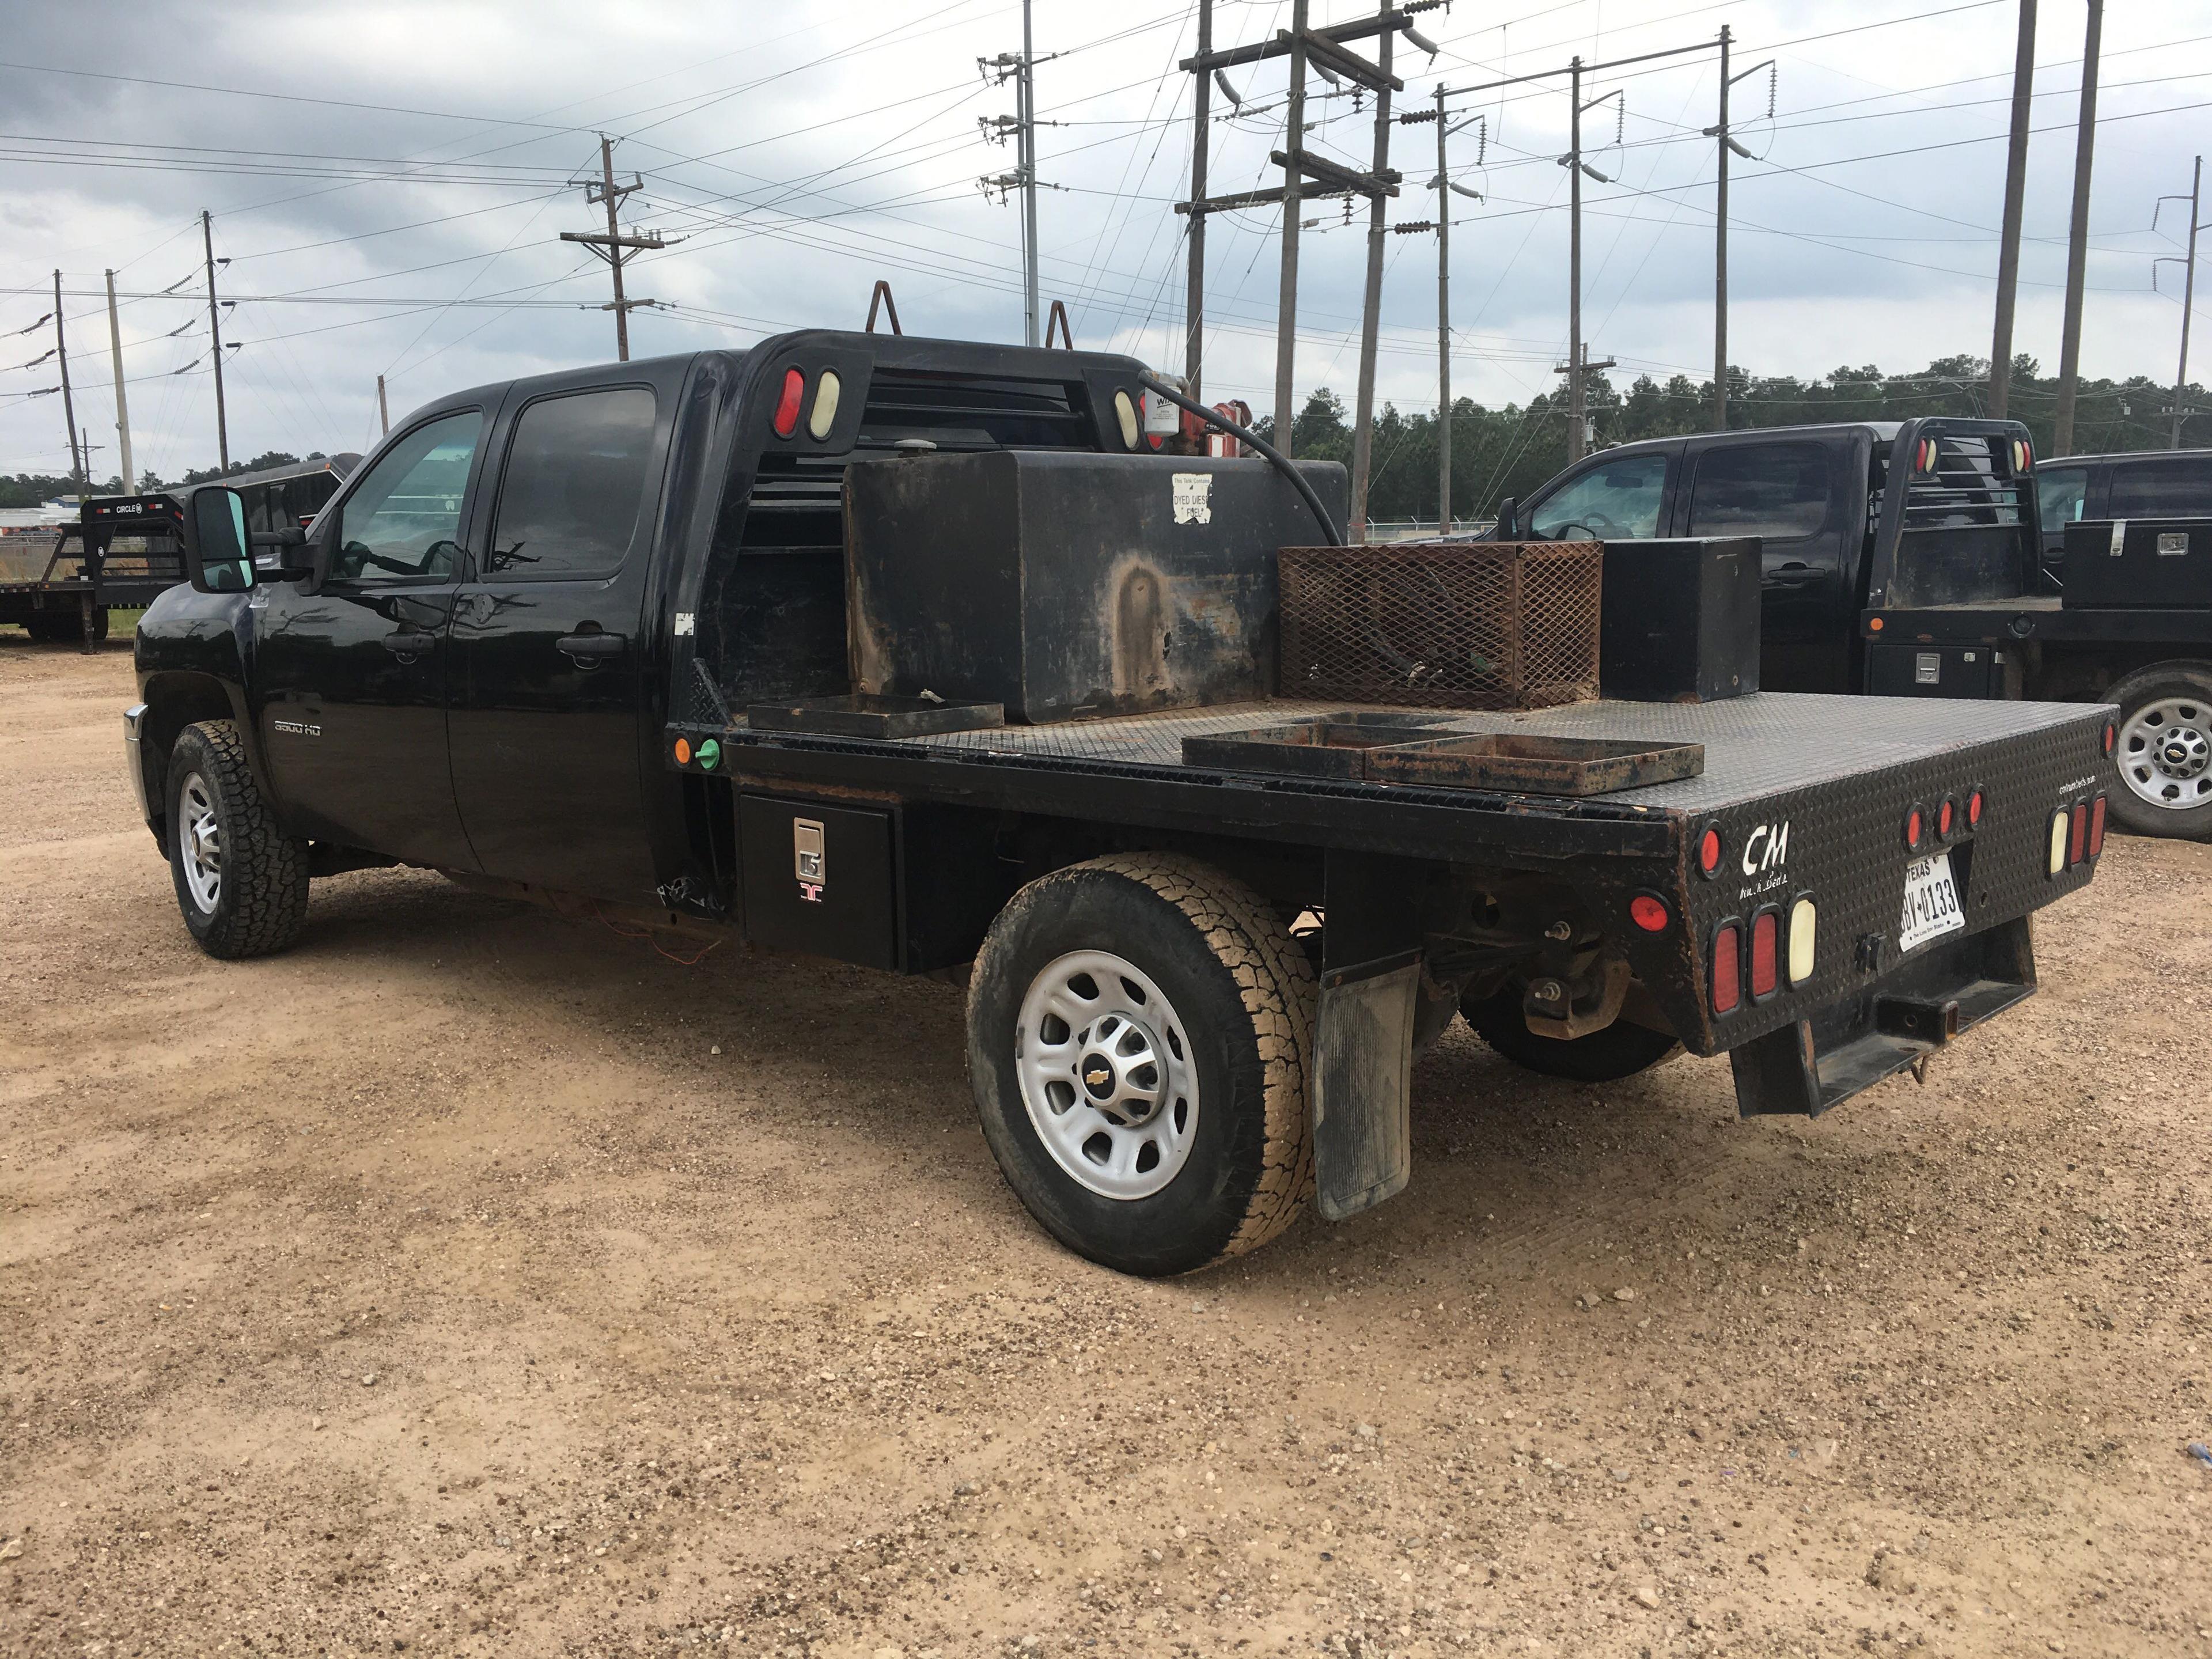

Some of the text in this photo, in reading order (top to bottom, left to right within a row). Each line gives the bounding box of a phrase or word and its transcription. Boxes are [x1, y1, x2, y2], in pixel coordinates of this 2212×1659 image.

[1174, 495, 1190, 505] DYED
[116, 505, 135, 513] CIRCLE
[1187, 508, 1202, 517] FUEL
[305, 725, 321, 736] HD
[1743, 821, 1789, 876] CM
[1907, 861, 1930, 882] TEXAS
